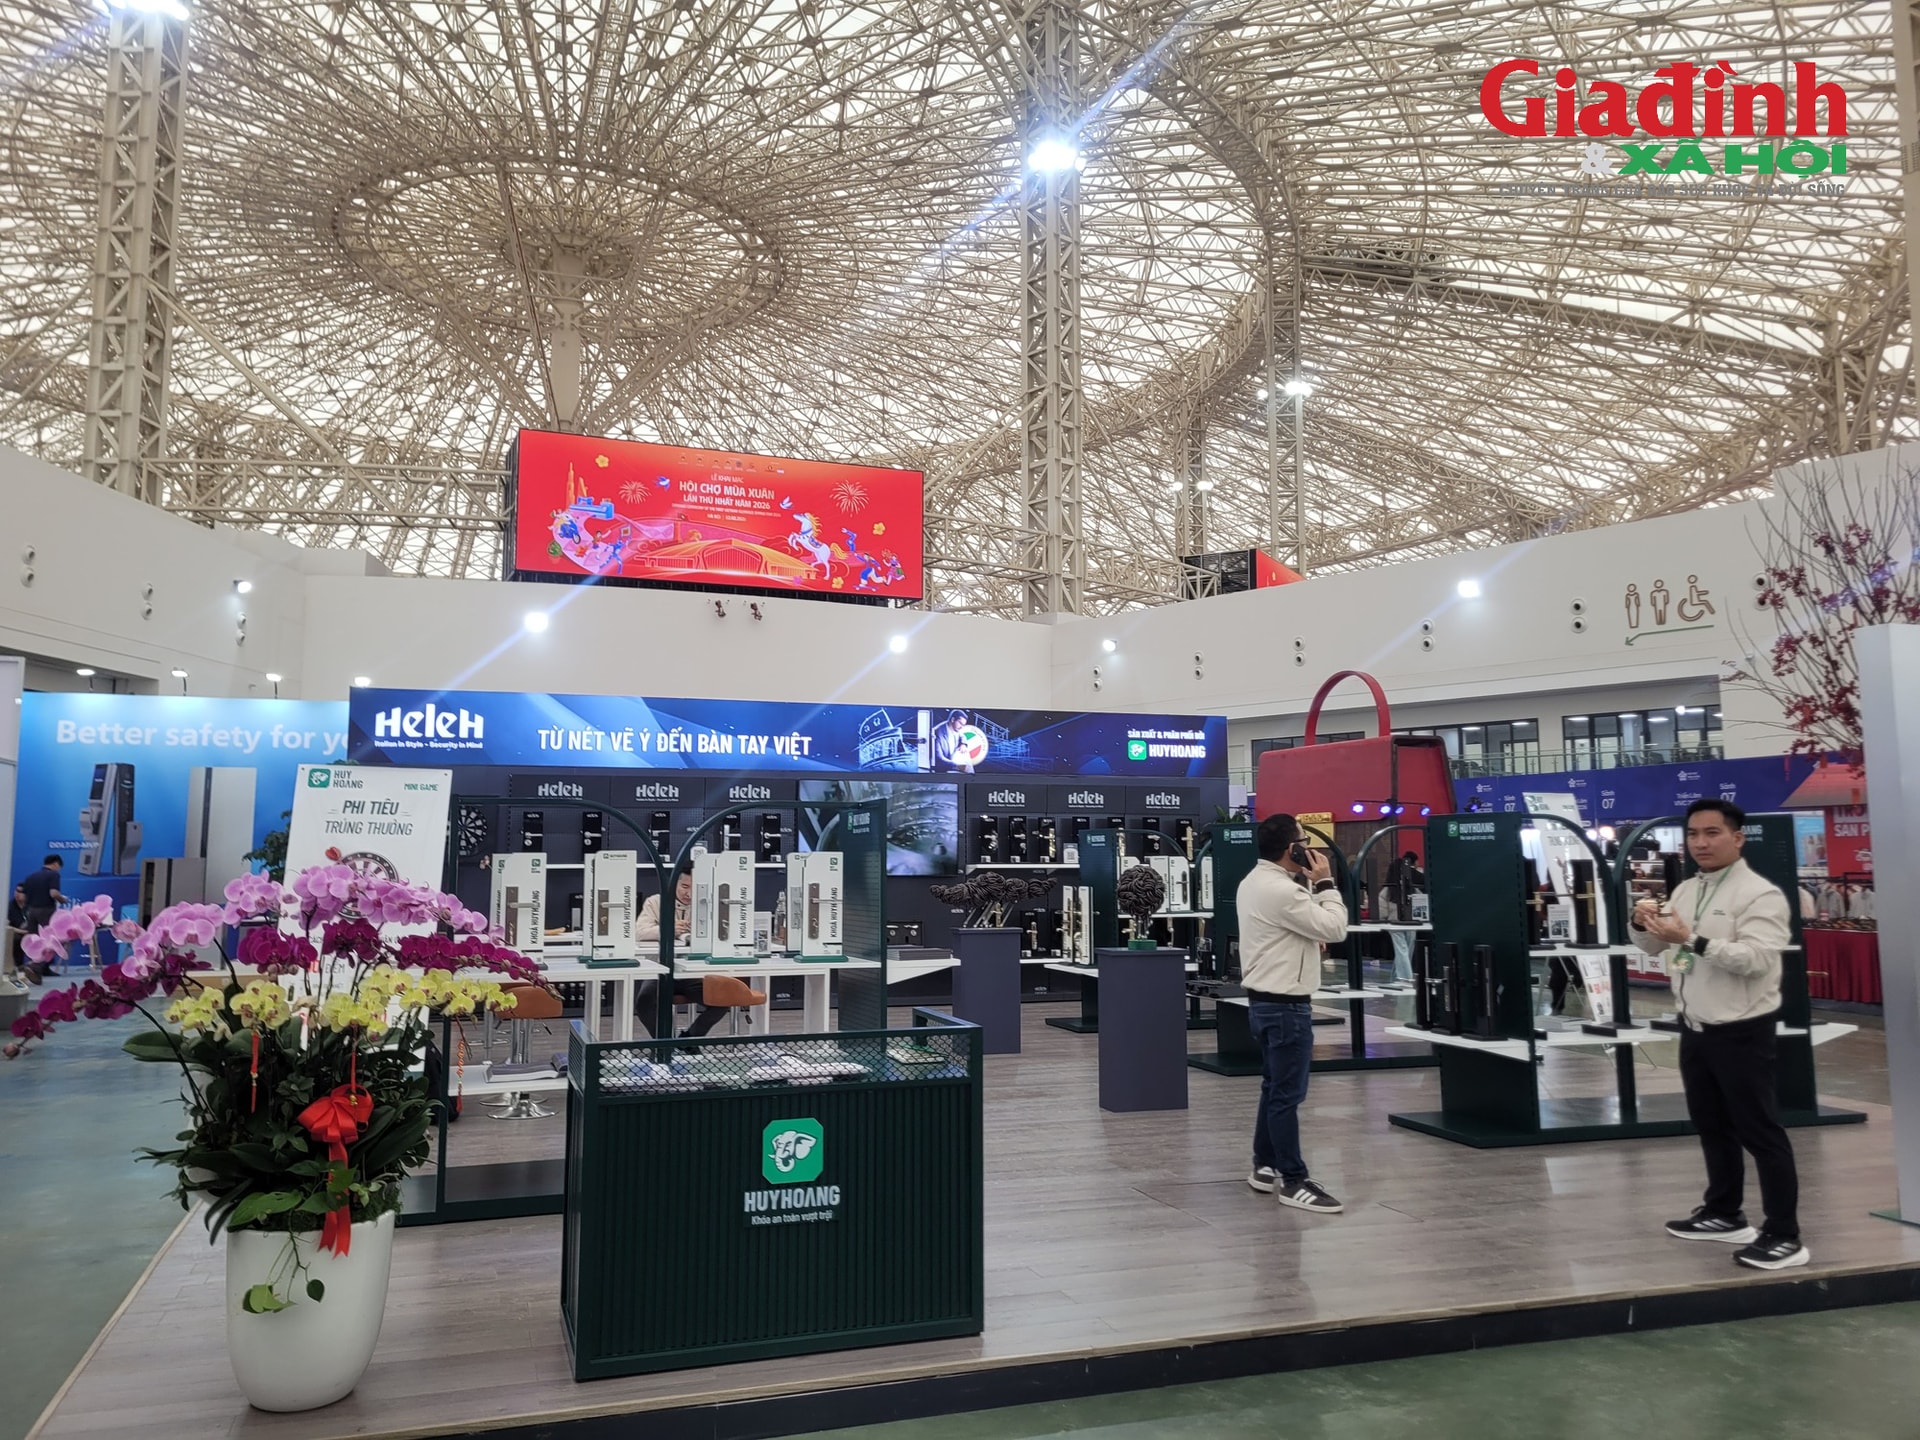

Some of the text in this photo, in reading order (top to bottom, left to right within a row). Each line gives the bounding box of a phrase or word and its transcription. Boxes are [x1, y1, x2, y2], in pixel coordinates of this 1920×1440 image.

[679, 480, 775, 500] HỘI CHỢ MÙA XUÂN
[752, 501, 771, 509] 2026
[56, 719, 158, 745] Better
[165, 722, 262, 755] safety
[270, 723, 316, 749] for
[1157, 731, 1163, 739] &
[538, 724, 812, 760] TỪ NÉT VẼ Ý ĐẾN BÀN TAY VIỆT
[1148, 744, 1206, 758] HUYHOANG
[333, 770, 352, 779] HUY
[332, 779, 364, 789] HOANG
[404, 783, 439, 791] MINI GAME
[1602, 798, 1615, 809] 07
[1720, 792, 1736, 803] 07
[342, 798, 399, 815] PHI TIÊU
[1504, 803, 1516, 812] 07
[325, 818, 363, 834] TRÚNG
[739, 887, 747, 921] HUYHANG
[830, 887, 838, 921] HUYHANG
[743, 1186, 840, 1212] HUYHOANG
[772, 1215, 782, 1224] an
[783, 1213, 800, 1223] toàn
